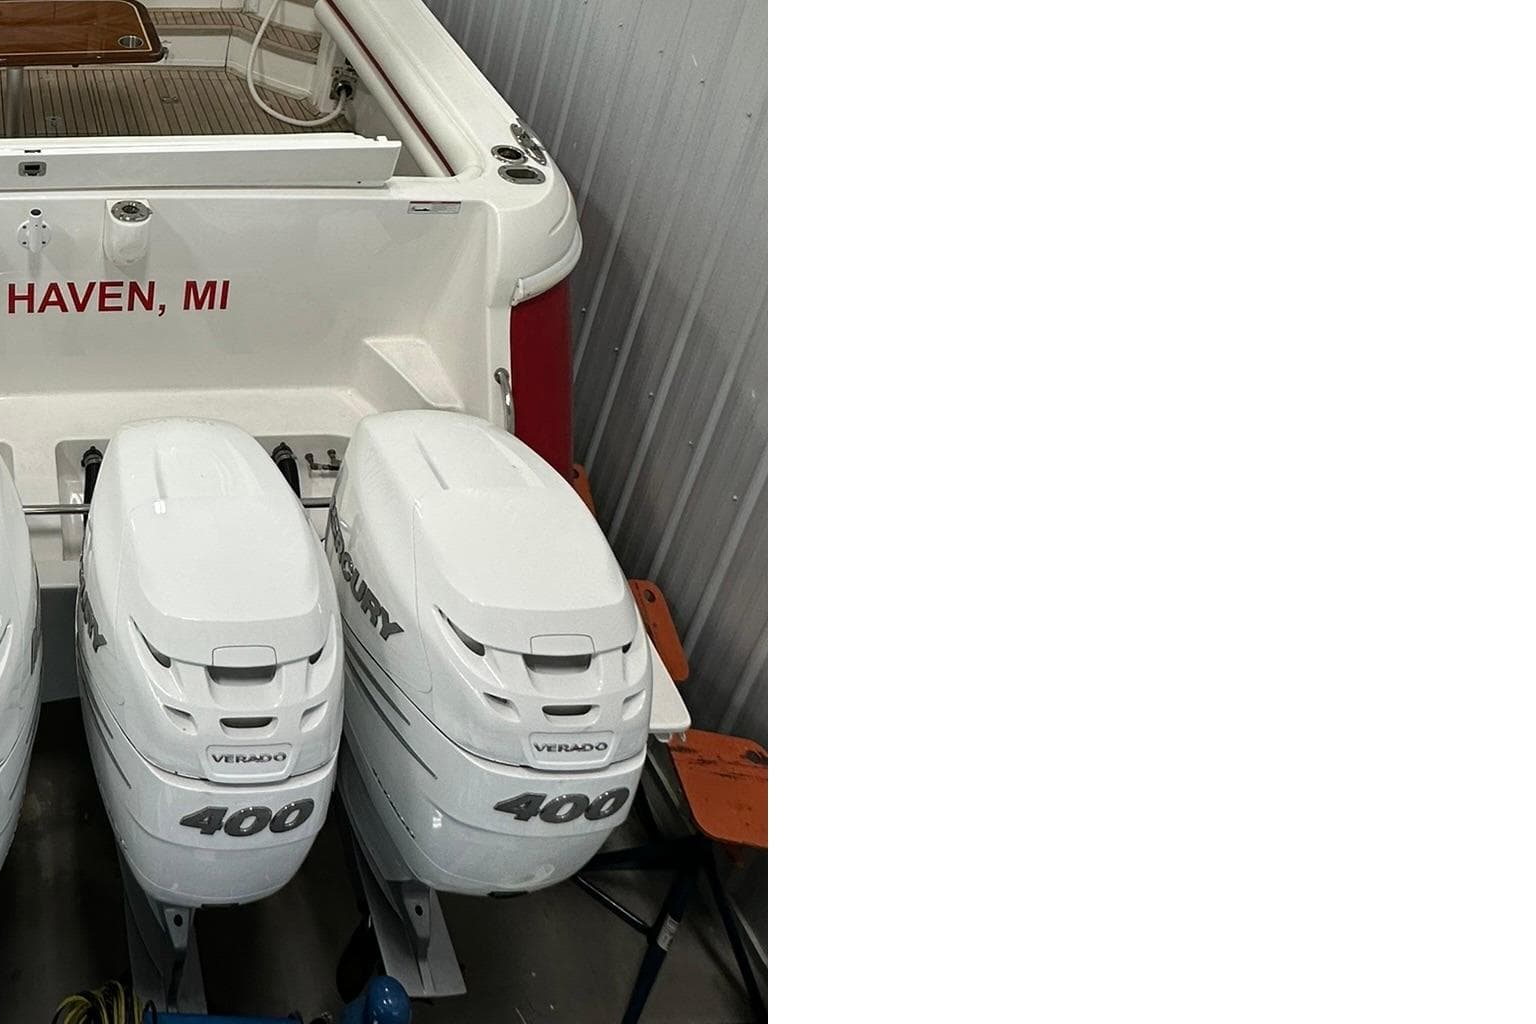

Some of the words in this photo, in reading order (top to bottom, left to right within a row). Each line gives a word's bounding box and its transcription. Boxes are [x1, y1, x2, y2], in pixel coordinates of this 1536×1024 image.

[8, 280, 166, 317] HAVEN,
[183, 279, 230, 311] MI
[212, 752, 287, 763] VERADO
[533, 742, 608, 753] VERADO
[179, 798, 315, 837] 400
[493, 787, 630, 824] 400
